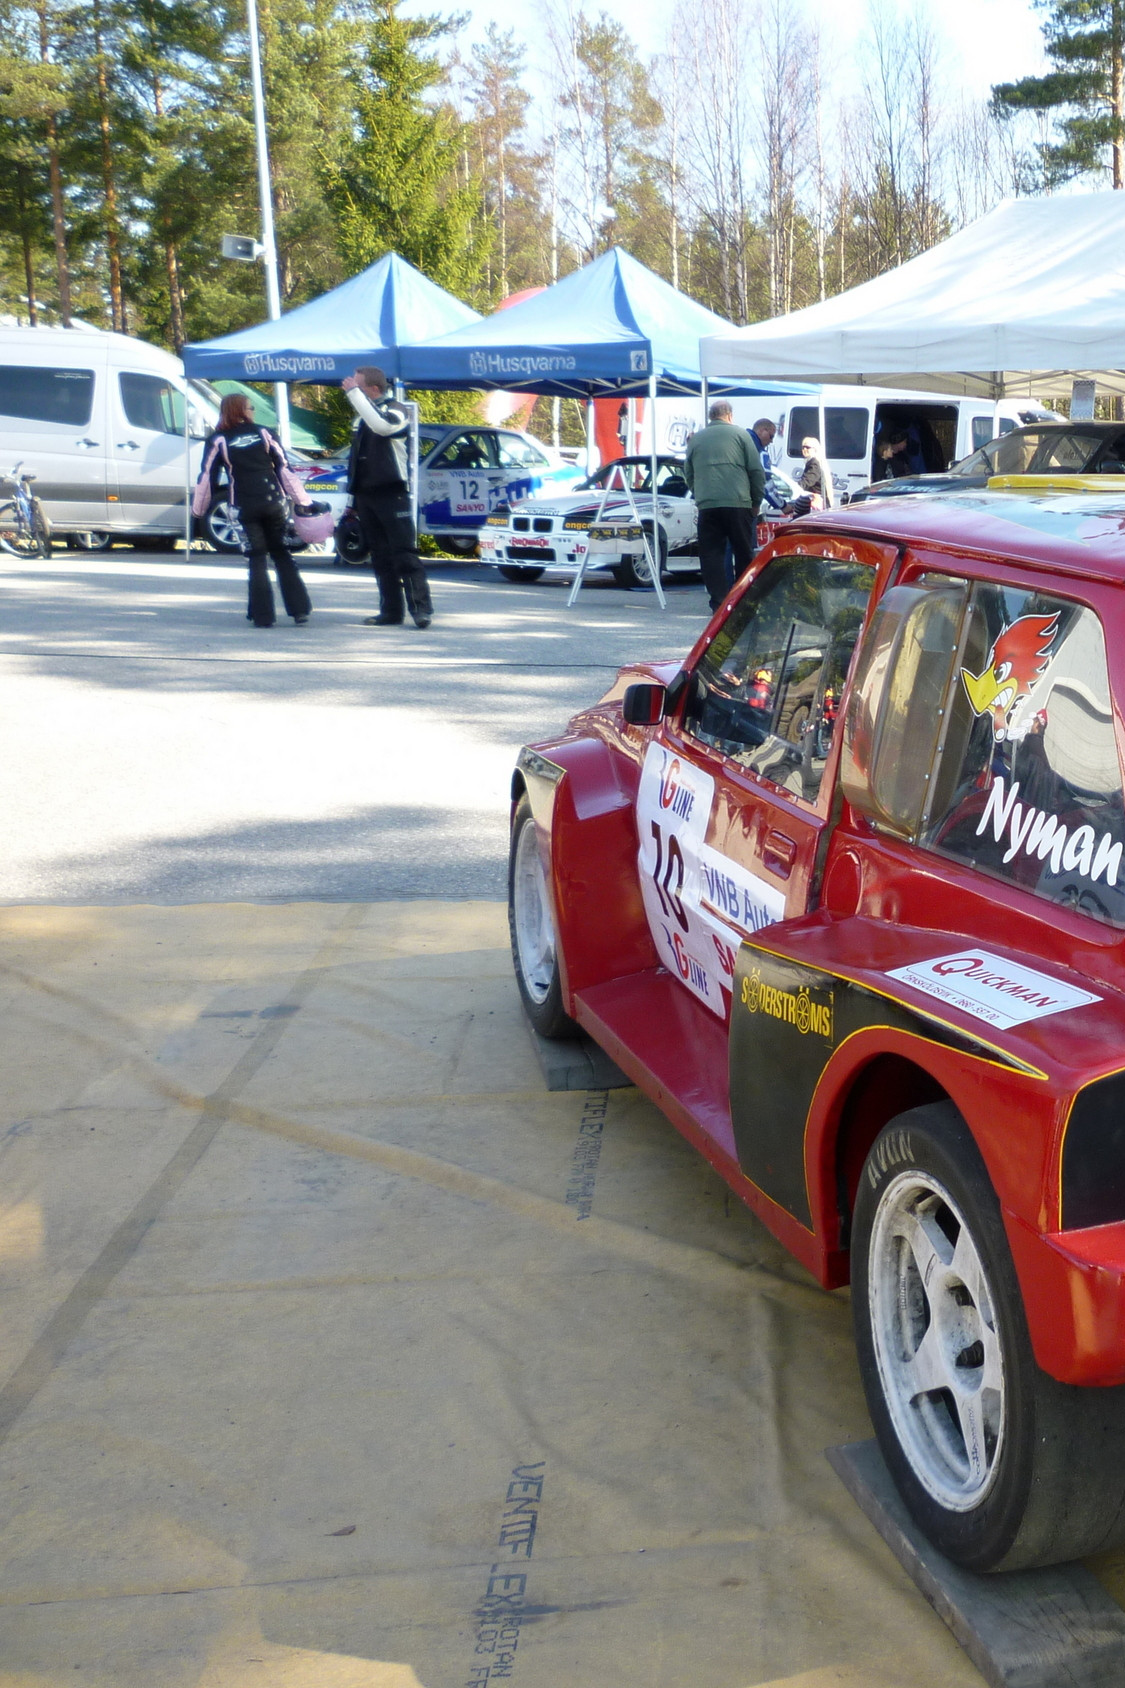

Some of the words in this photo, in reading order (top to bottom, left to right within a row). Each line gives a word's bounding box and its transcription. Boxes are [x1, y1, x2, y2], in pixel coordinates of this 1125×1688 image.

[260, 354, 335, 373] Husqvarna
[488, 354, 576, 374] Husqvarna
[456, 504, 485, 512] SANYO
[460, 481, 479, 499] 12
[672, 786, 695, 822] LINE
[976, 776, 1123, 886] Nyman
[704, 862, 739, 918] VNB
[689, 958, 709, 996] LINE
[742, 967, 830, 1036] SÖDERSTRÖMS
